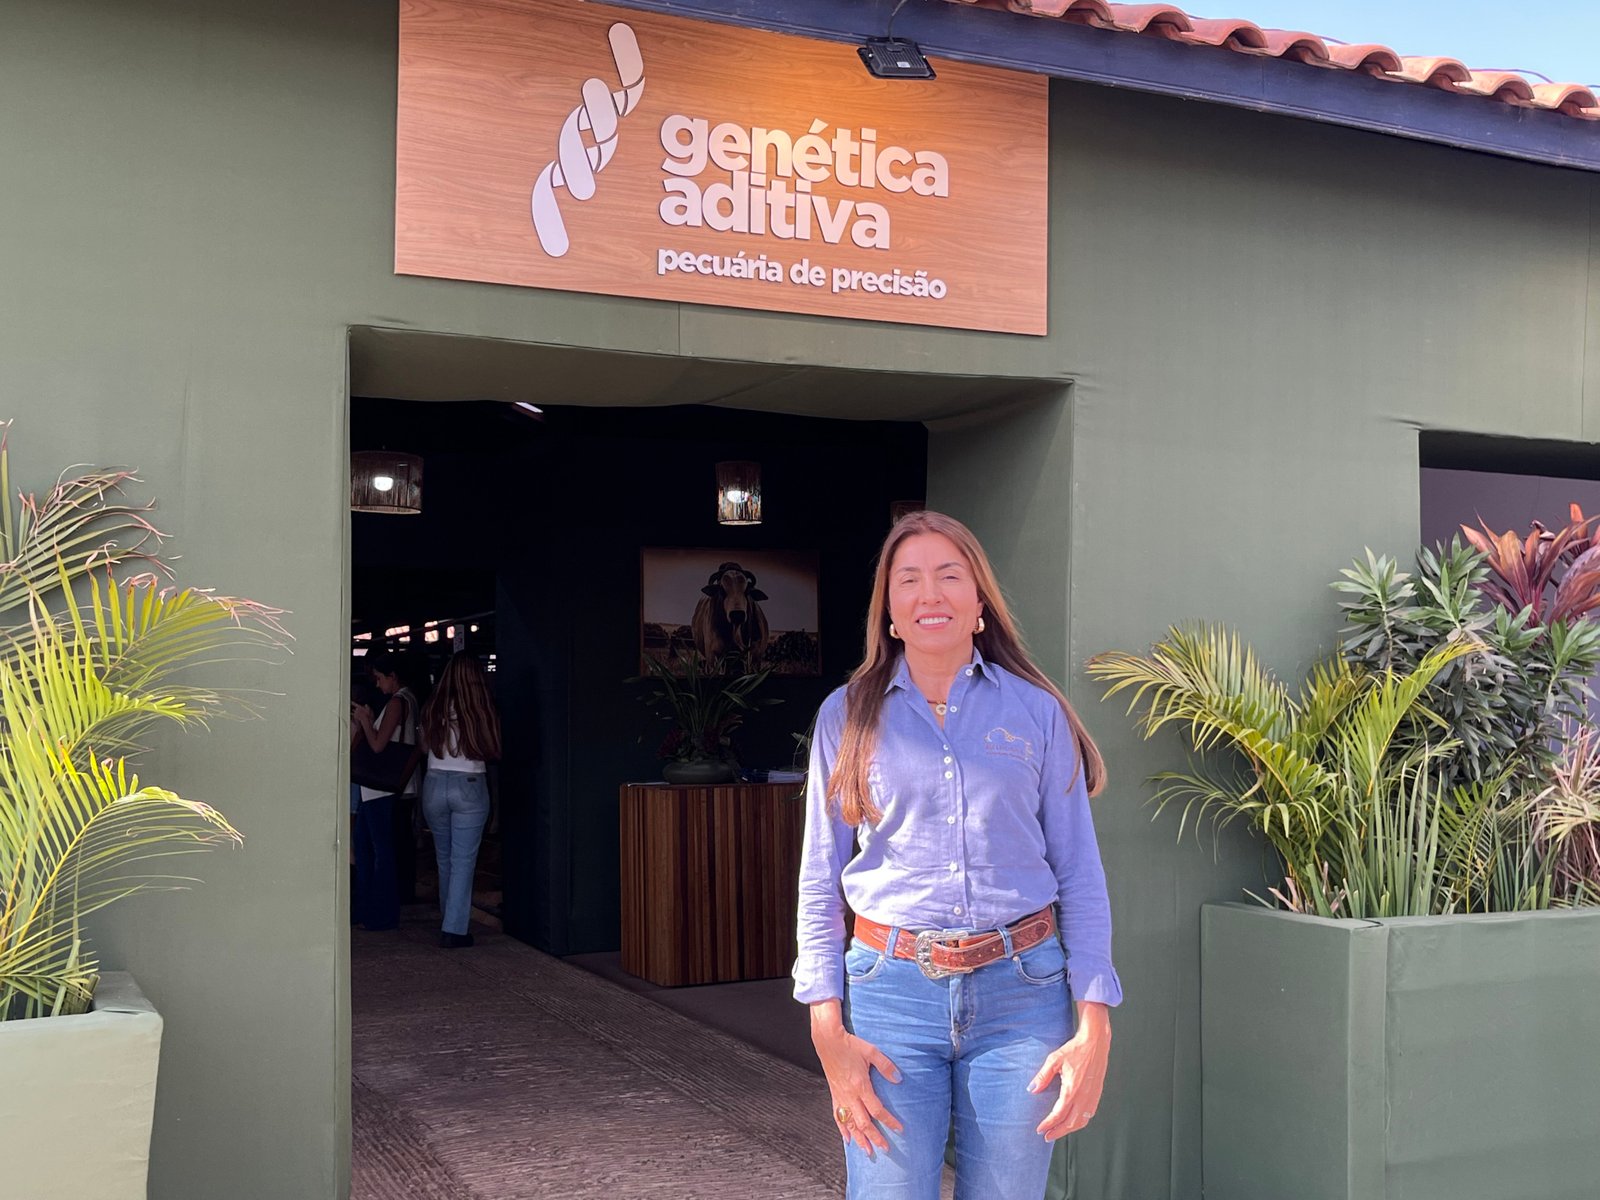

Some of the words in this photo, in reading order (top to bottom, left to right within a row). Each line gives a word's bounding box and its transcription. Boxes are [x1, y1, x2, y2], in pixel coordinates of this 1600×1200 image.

[660, 114, 950, 197] genética
[659, 170, 891, 249] aditiva
[658, 248, 784, 283] pecuária
[790, 258, 827, 287] de
[832, 264, 947, 299] precisão
